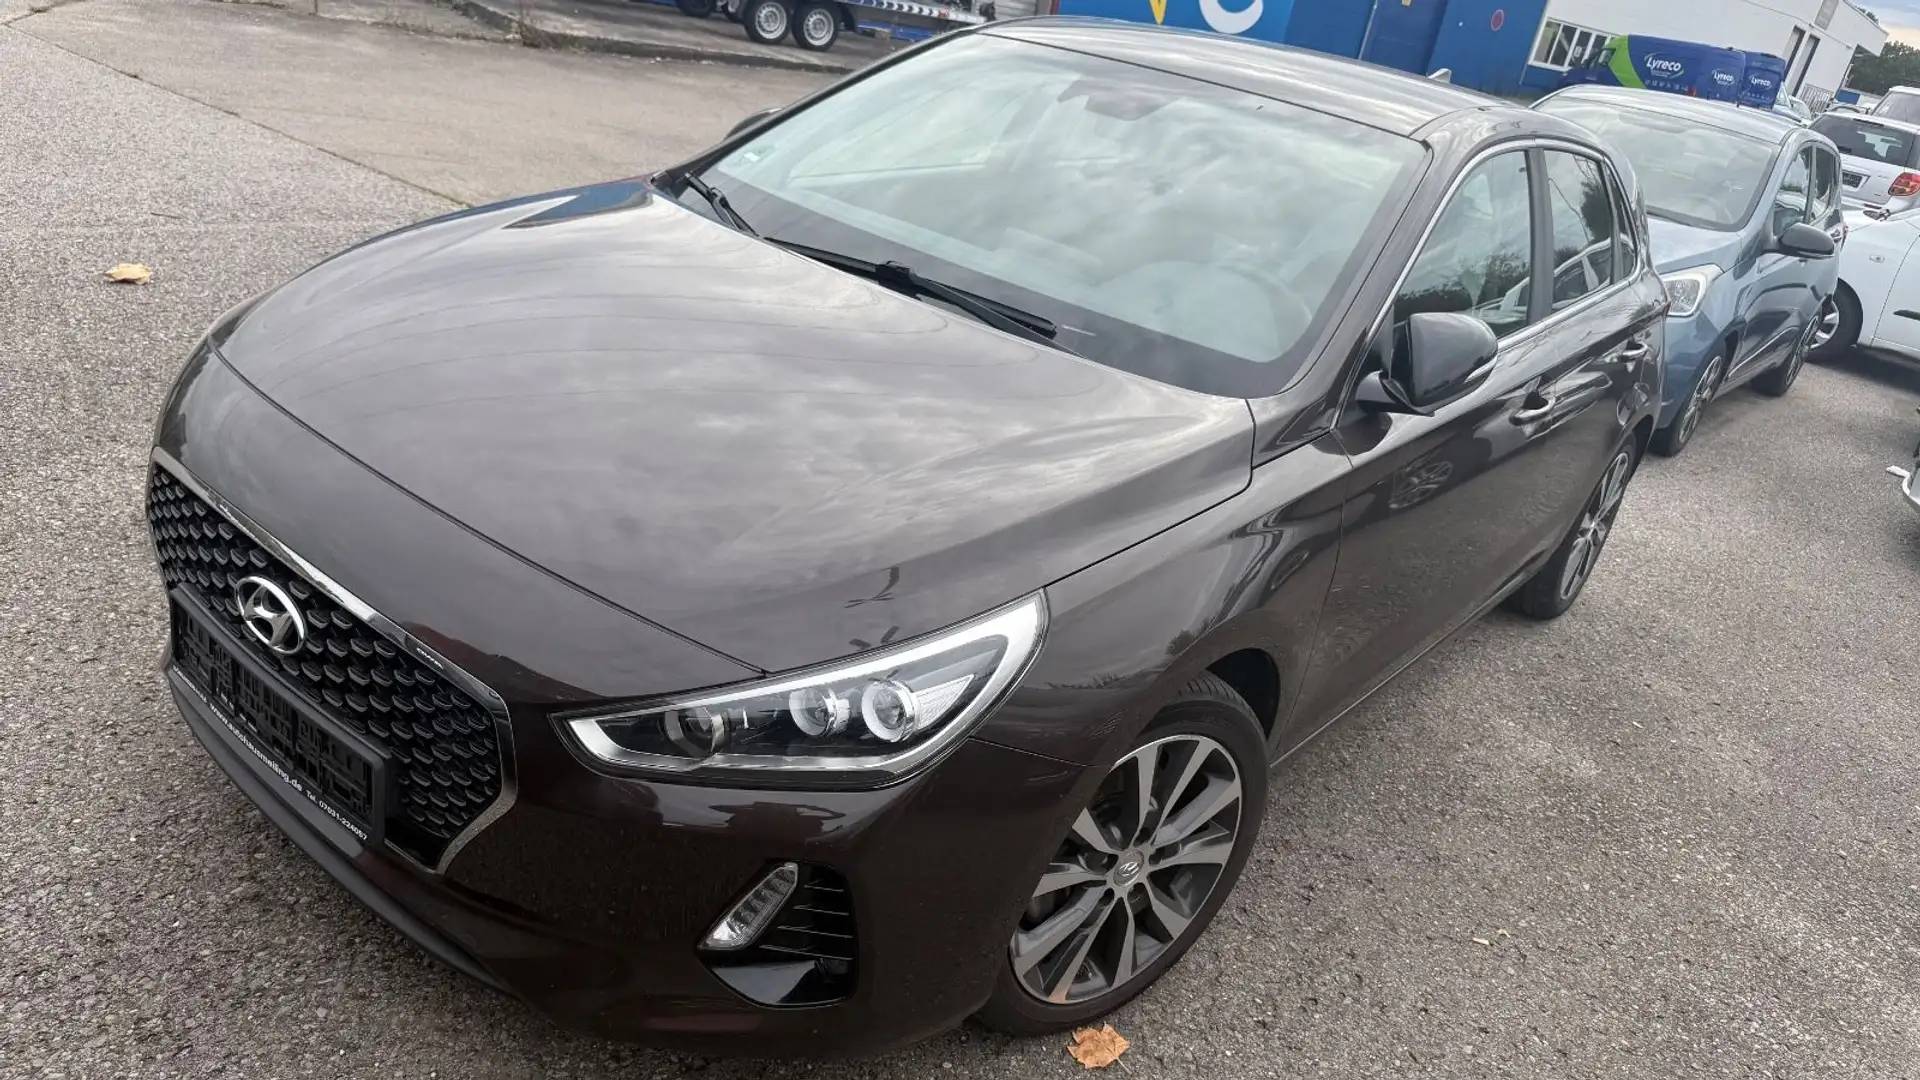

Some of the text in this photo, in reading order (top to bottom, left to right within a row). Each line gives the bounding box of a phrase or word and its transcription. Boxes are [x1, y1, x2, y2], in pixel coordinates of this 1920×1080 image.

[1646, 56, 1682, 73] Lyreco
[1713, 71, 1734, 82] Lyreco
[1750, 76, 1771, 87] Lyreco
[306, 790, 318, 804] Tel.
